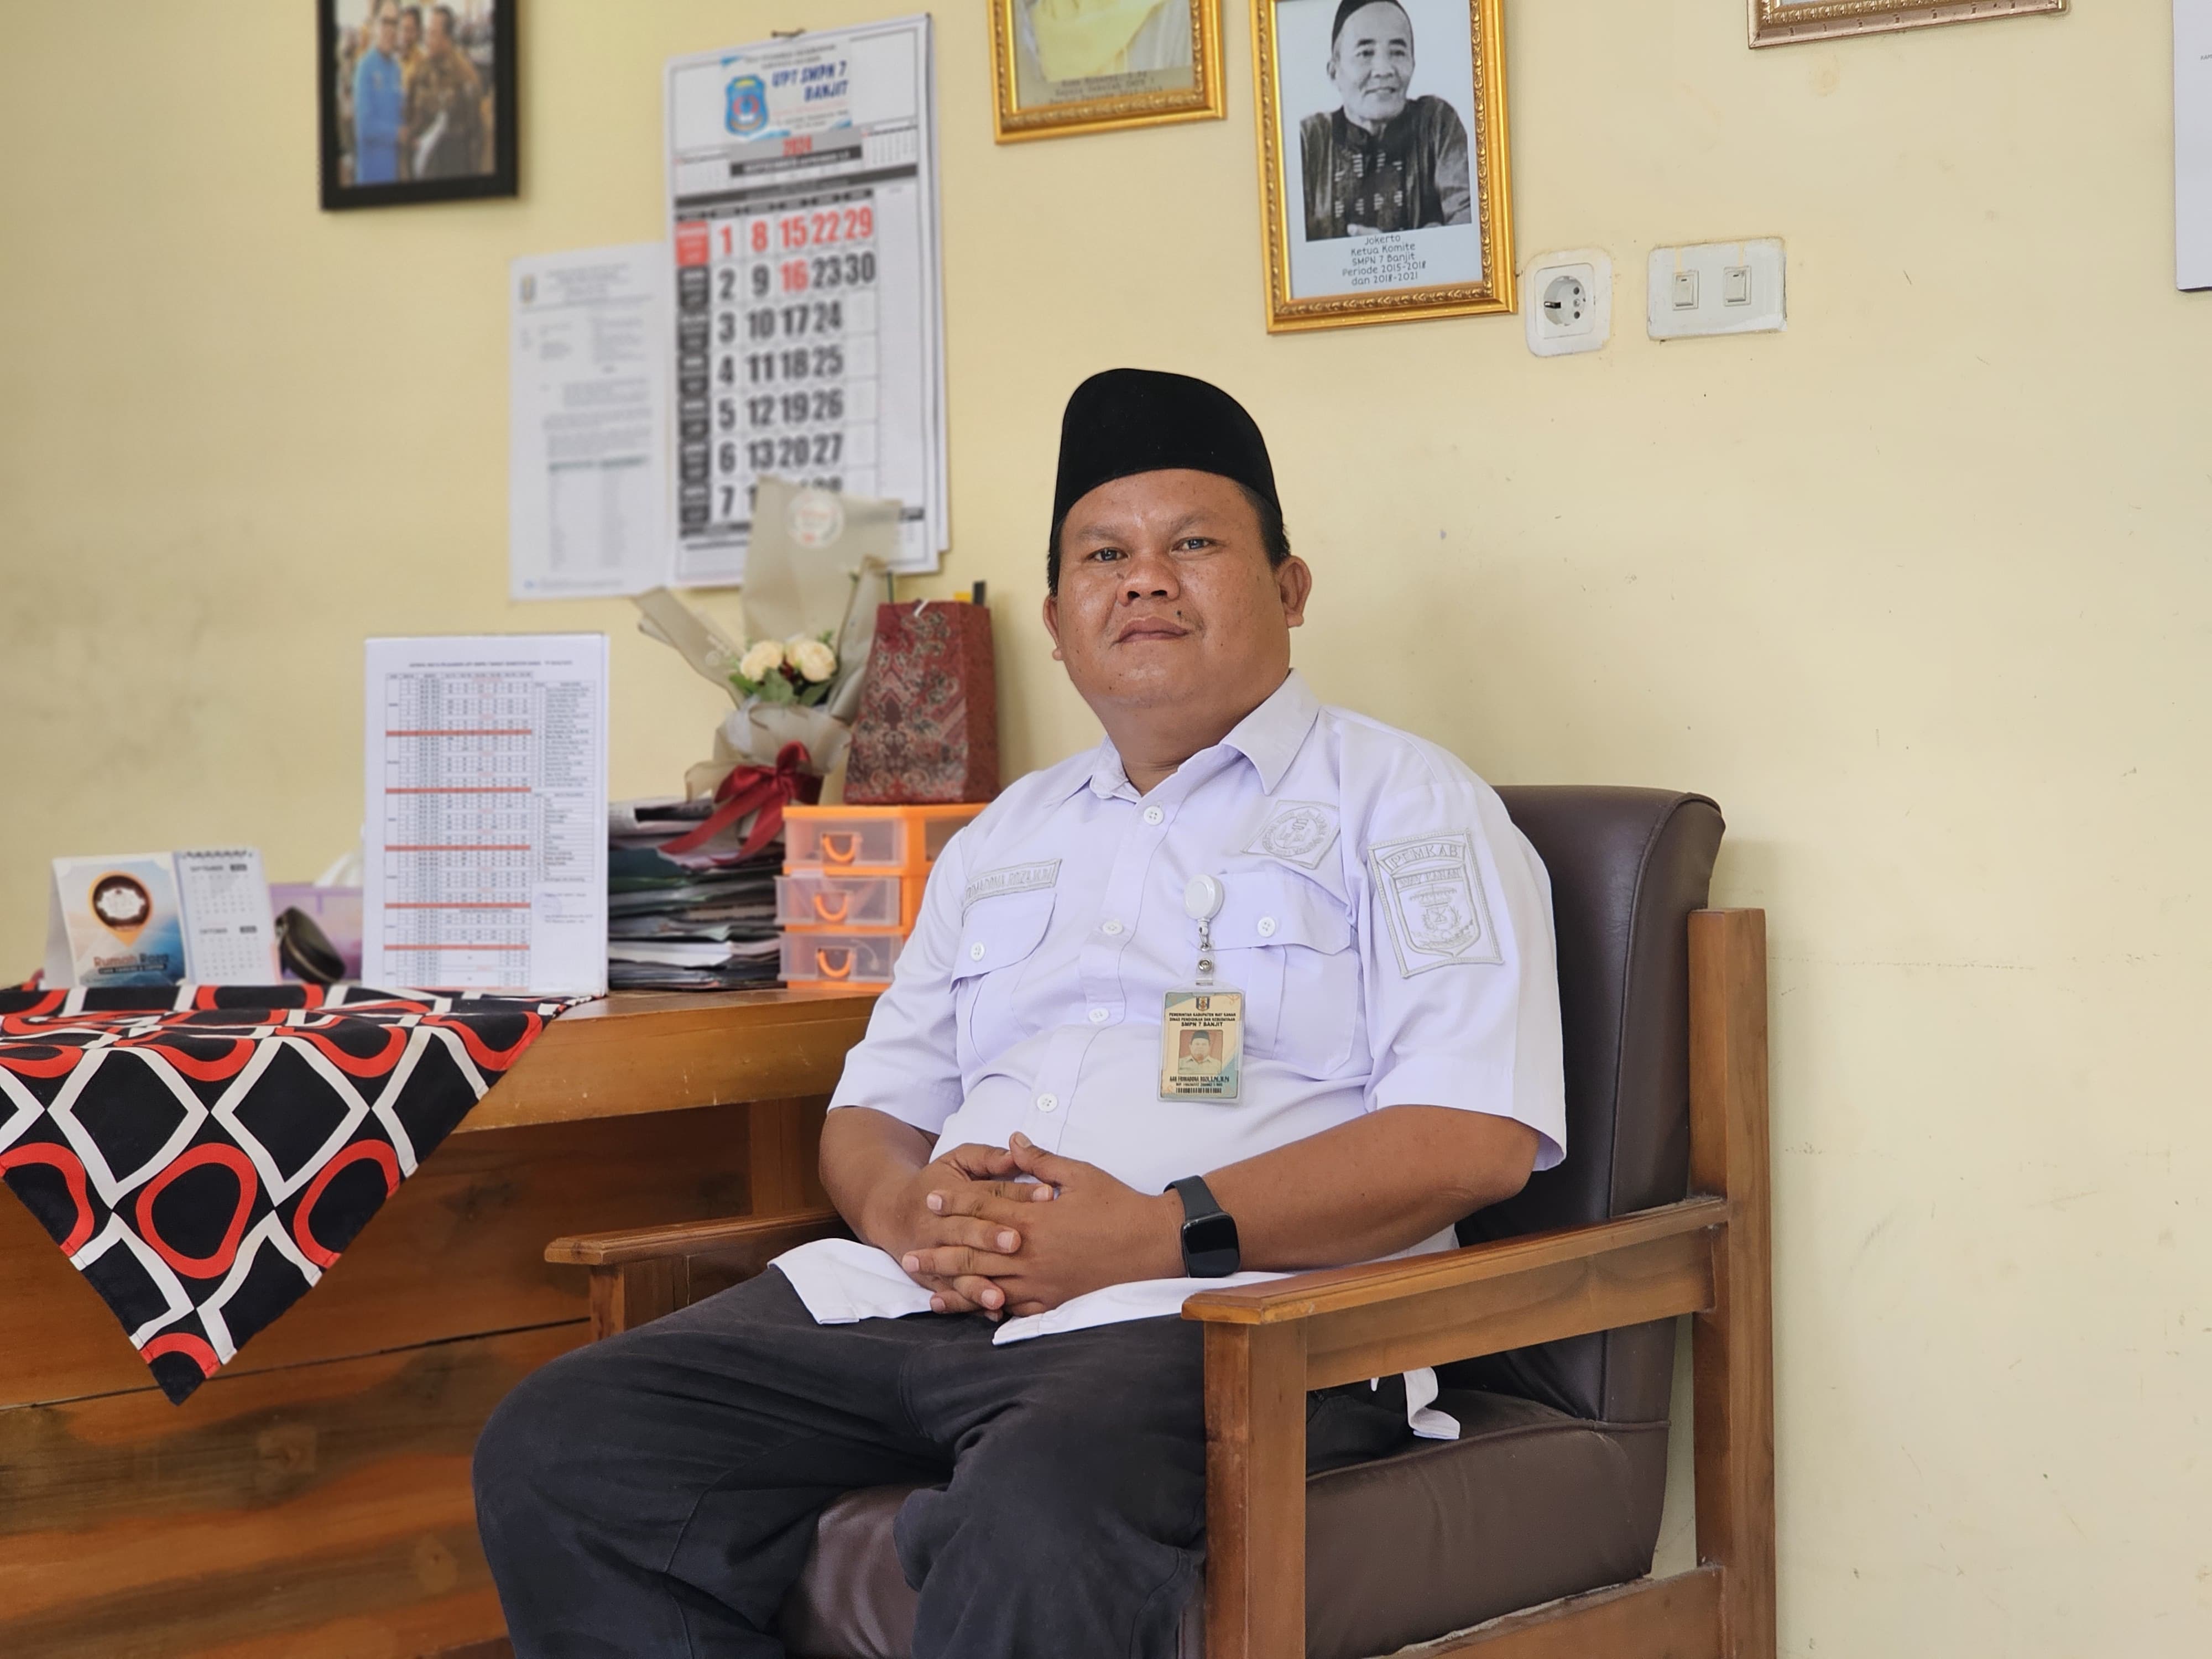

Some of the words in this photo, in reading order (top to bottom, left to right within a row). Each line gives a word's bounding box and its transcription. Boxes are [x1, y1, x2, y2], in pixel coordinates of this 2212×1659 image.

[839, 60, 847, 76] 7
[722, 227, 732, 255] 1
[752, 221, 768, 252] 8
[780, 217, 807, 248] 15
[812, 213, 839, 244] 22
[845, 207, 873, 240] 29
[1365, 235, 1401, 245] Jokerto
[1351, 247, 1379, 256] Ketua
[1383, 242, 1415, 253] Komite
[1352, 255, 1376, 265] SMPN
[1387, 252, 1415, 263] Banjit
[719, 269, 735, 300] 2
[752, 264, 769, 296] 9
[781, 260, 807, 292] 16
[812, 256, 842, 289] 23
[846, 252, 875, 285] 30
[1342, 267, 1378, 276] Periode
[1382, 260, 1426, 273] 2015-2018
[1352, 277, 1370, 285] dan
[1374, 272, 1418, 283] 2018-2021
[719, 311, 735, 342] 3
[747, 308, 774, 340] 10
[781, 305, 808, 334] 17
[813, 301, 842, 331] 24
[719, 356, 734, 385] 4
[747, 352, 774, 382] 11
[781, 349, 808, 380] 18
[813, 345, 843, 376] 25
[719, 399, 735, 430] 5
[748, 397, 774, 427] 12
[781, 393, 808, 423] 19
[813, 389, 843, 420] 26
[719, 442, 735, 474] 6
[748, 439, 774, 469] 13
[779, 436, 808, 467] 20
[813, 433, 843, 464] 27
[720, 486, 734, 516] 7
[1389, 844, 1458, 869] PEMKAB
